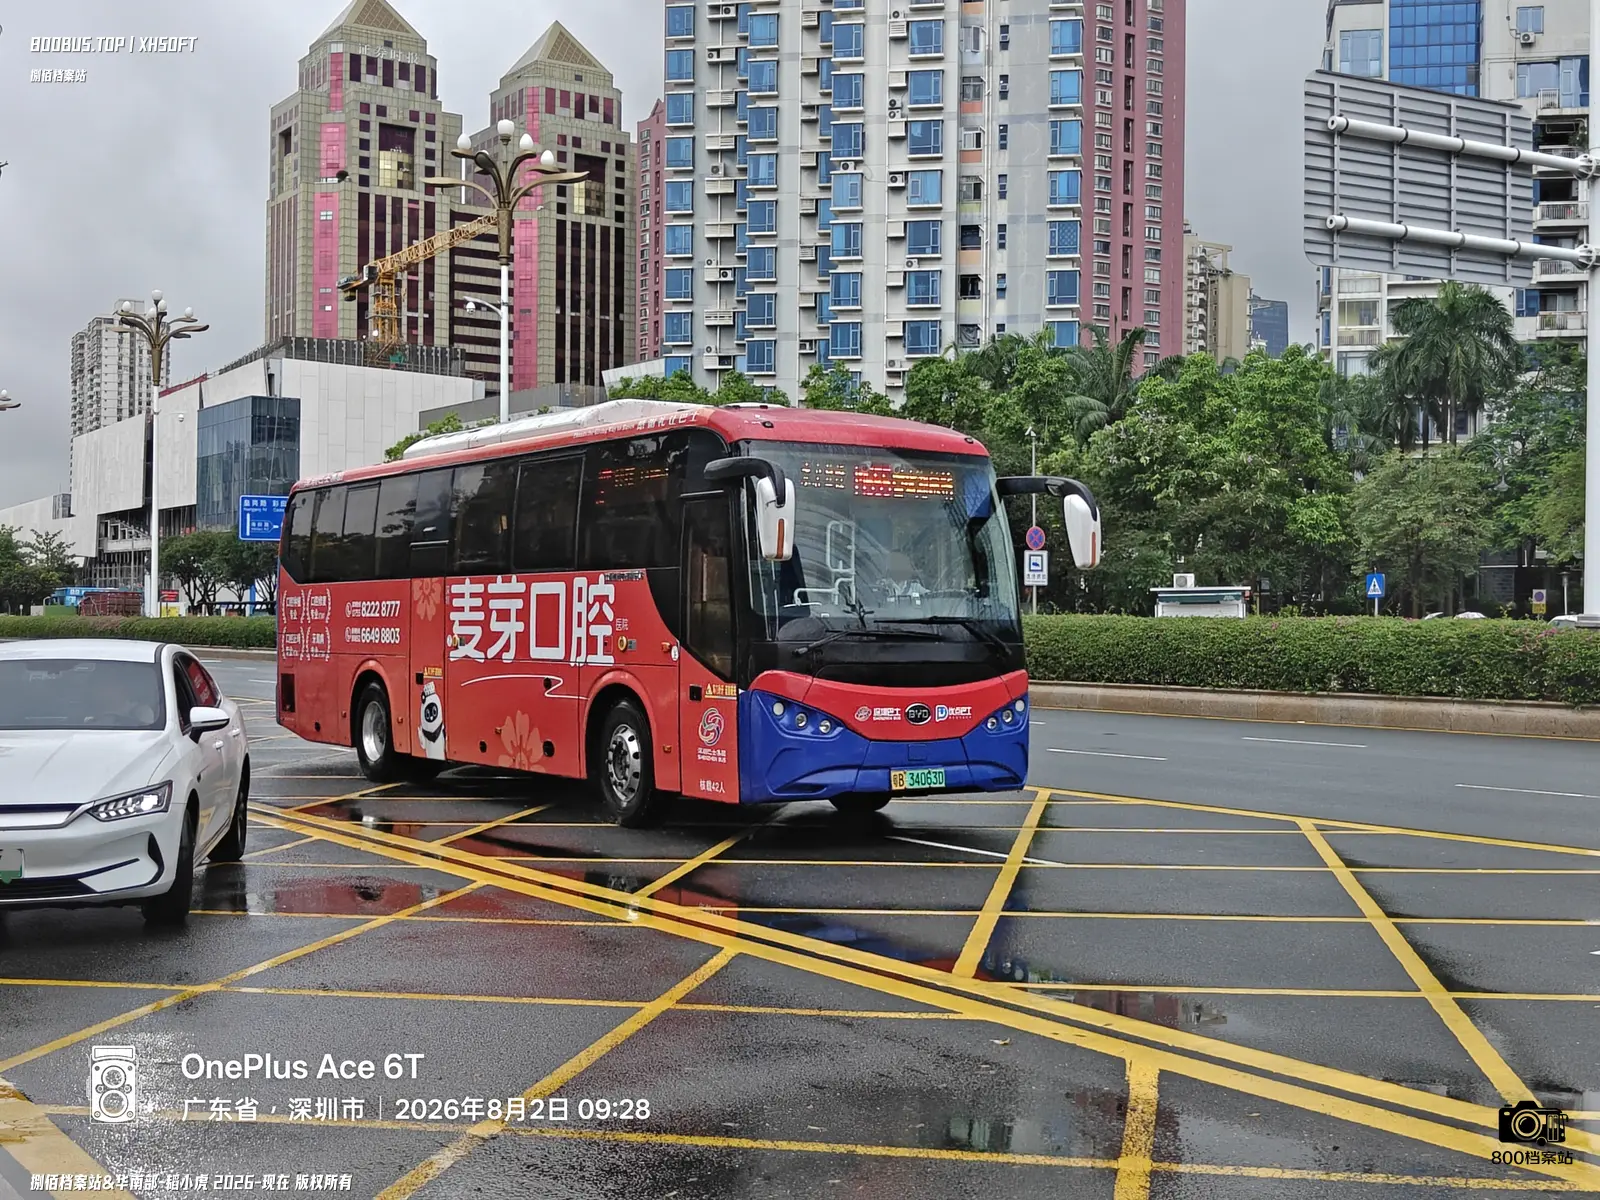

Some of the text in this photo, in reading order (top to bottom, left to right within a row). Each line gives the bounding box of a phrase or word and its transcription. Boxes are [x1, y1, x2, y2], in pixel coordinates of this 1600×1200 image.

[359, 43, 418, 64] 证券时报
[361, 600, 400, 617] 8222 8777
[450, 573, 615, 667] 麦芽口腔
[615, 617, 629, 631] 医院
[361, 627, 380, 643] 6649
[381, 627, 400, 644] 8803
[873, 707, 901, 717] 深圳巴士
[908, 709, 929, 719] BYD
[699, 779, 726, 794] 核载42人
[908, 770, 944, 787] 34063D
